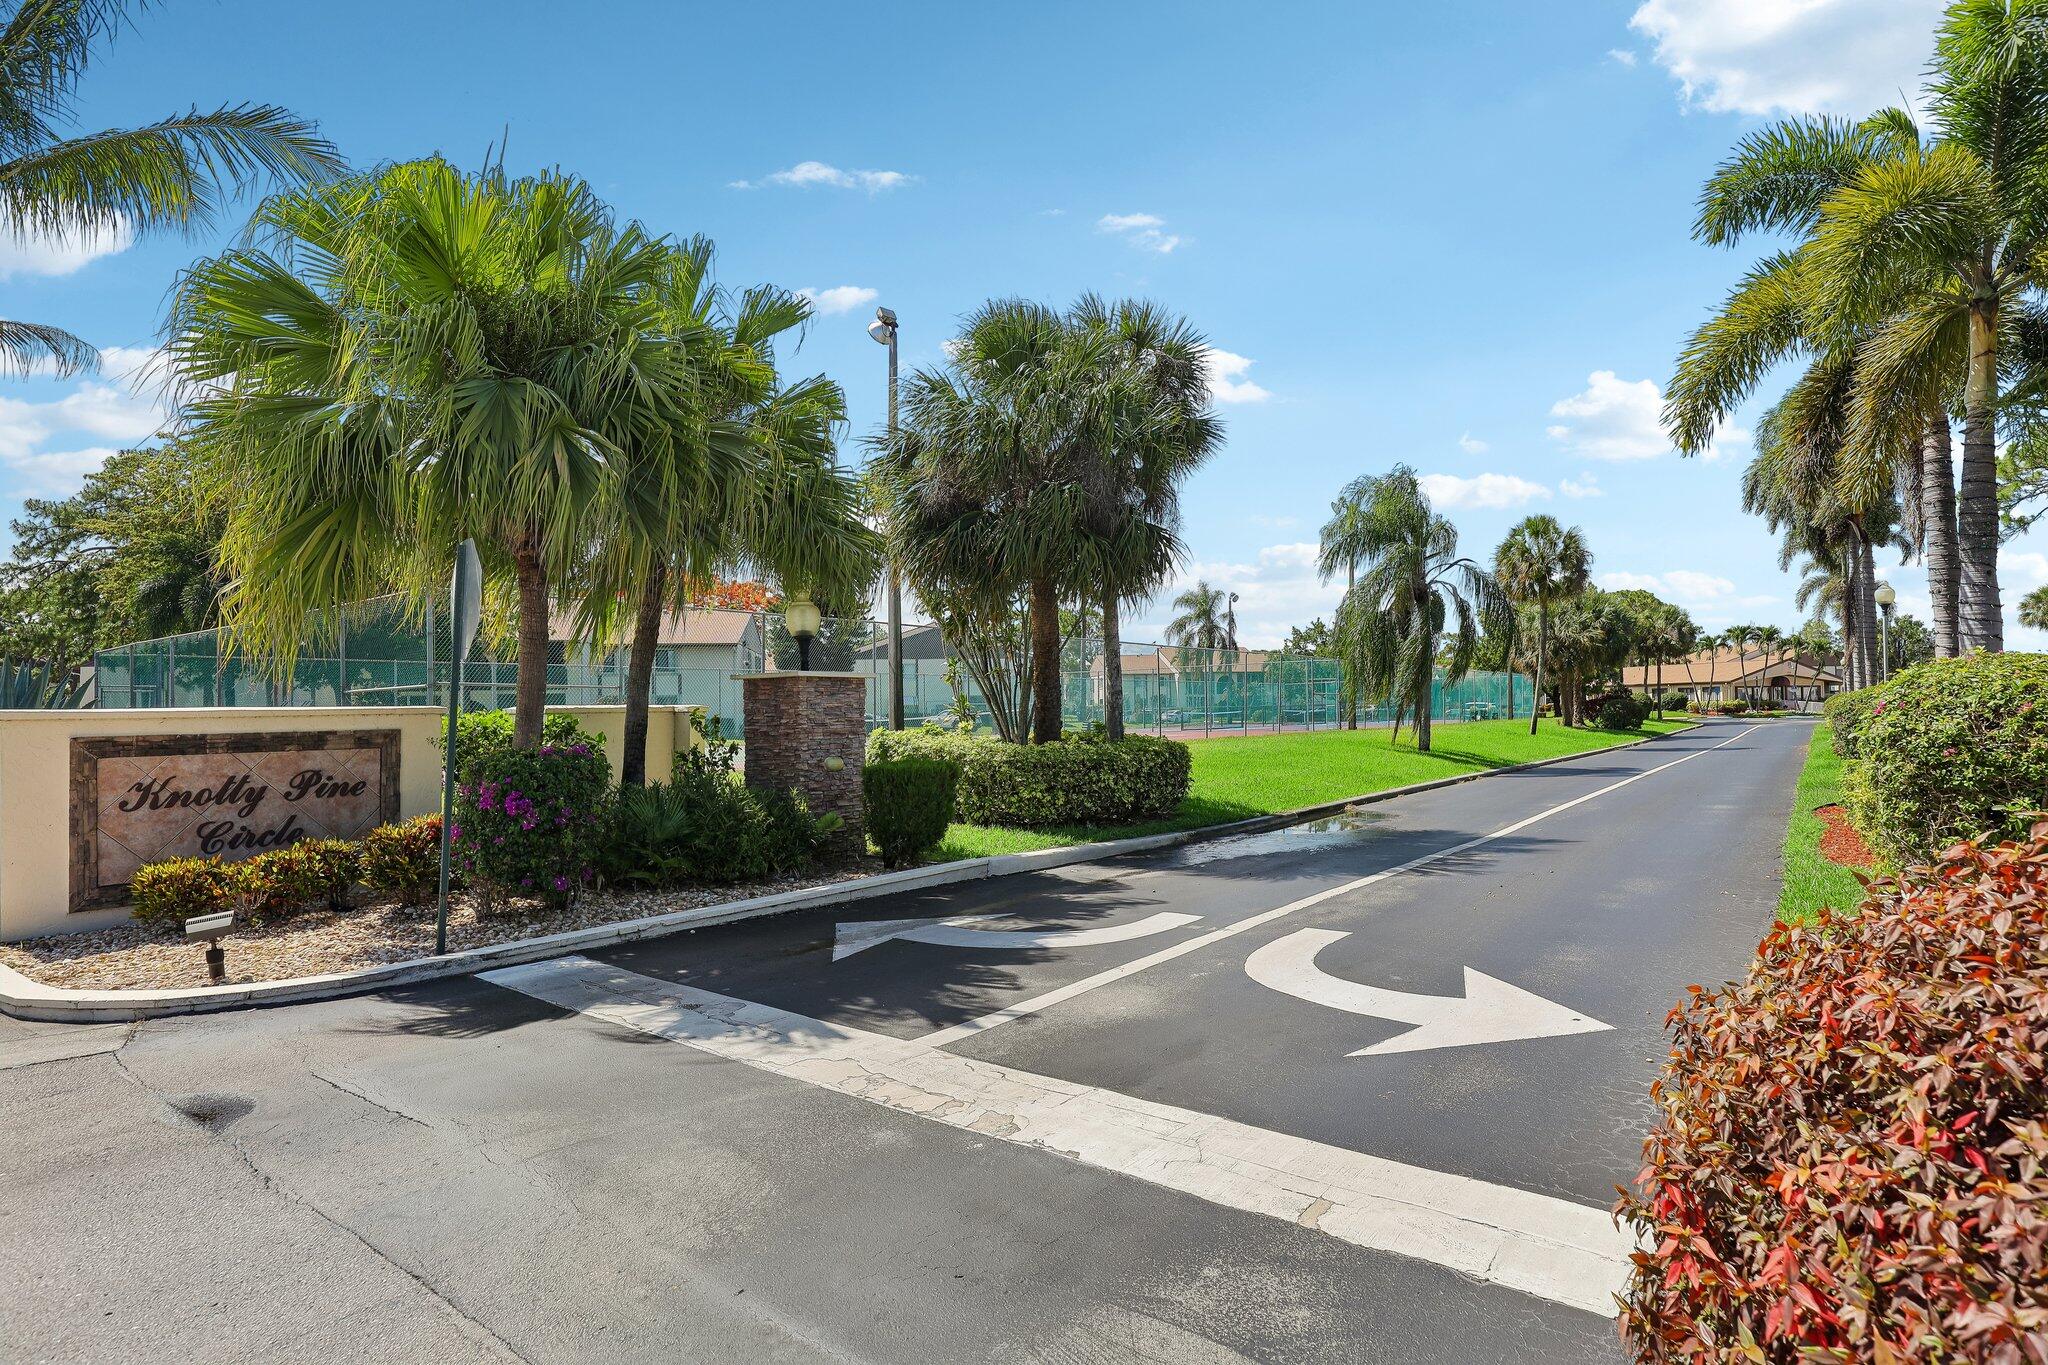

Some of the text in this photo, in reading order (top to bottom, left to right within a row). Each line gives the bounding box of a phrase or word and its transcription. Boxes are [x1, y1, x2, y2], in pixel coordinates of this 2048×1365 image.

[119, 769, 367, 818] Knotty Pine
[196, 815, 304, 855] Circle
